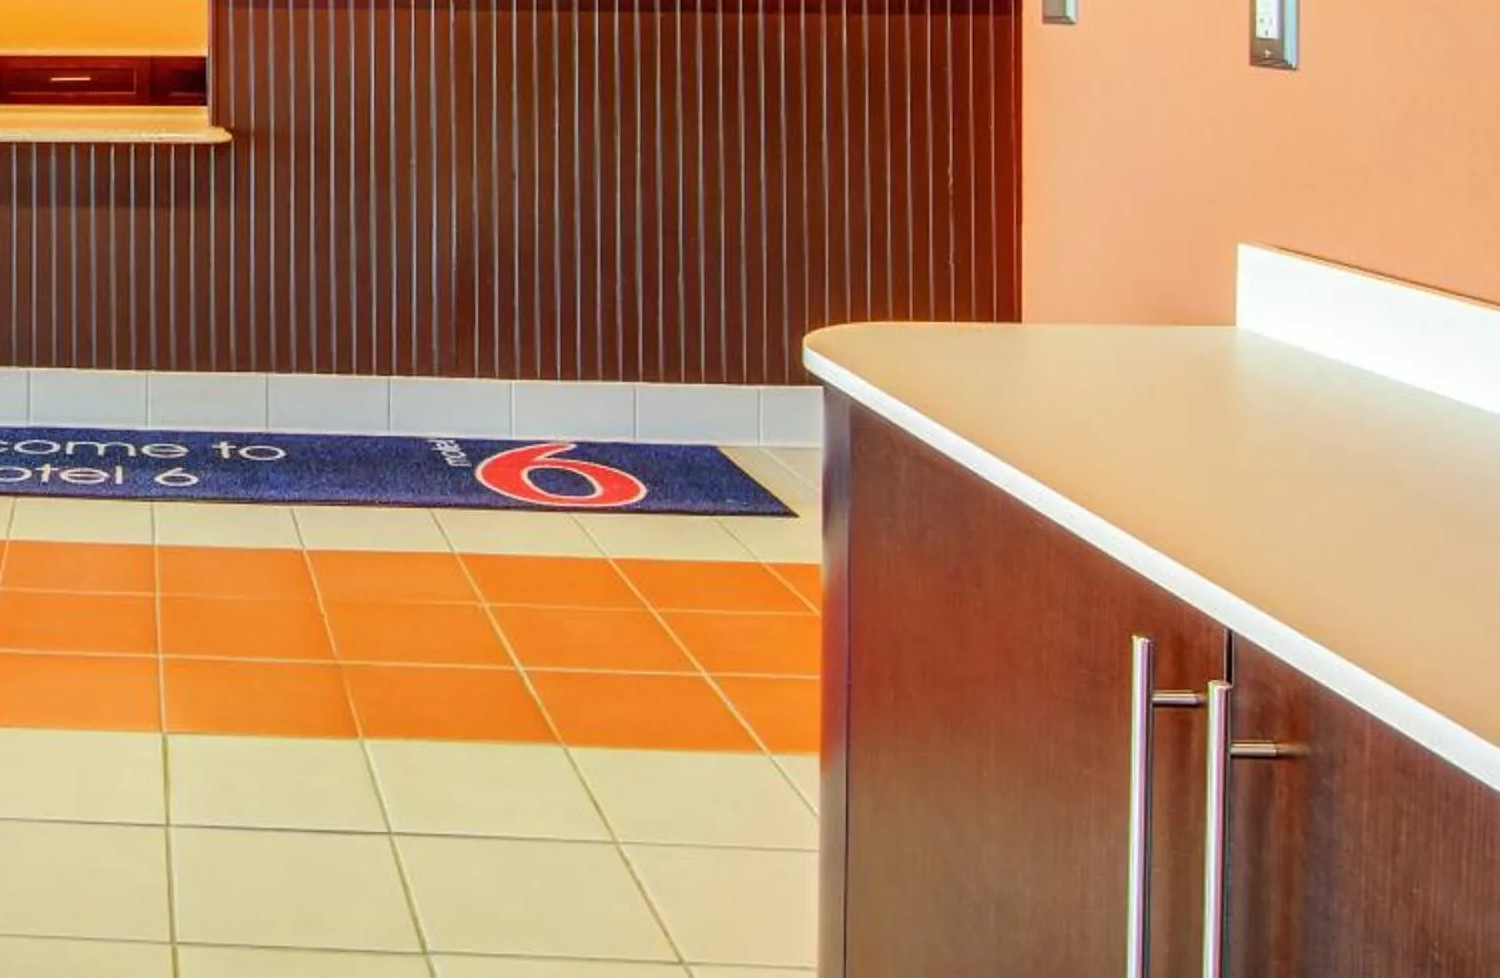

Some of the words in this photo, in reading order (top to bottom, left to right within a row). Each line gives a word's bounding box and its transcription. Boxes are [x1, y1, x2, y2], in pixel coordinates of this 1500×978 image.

[212, 440, 287, 461] to
[154, 467, 199, 488] 6
[475, 442, 647, 507] 6
